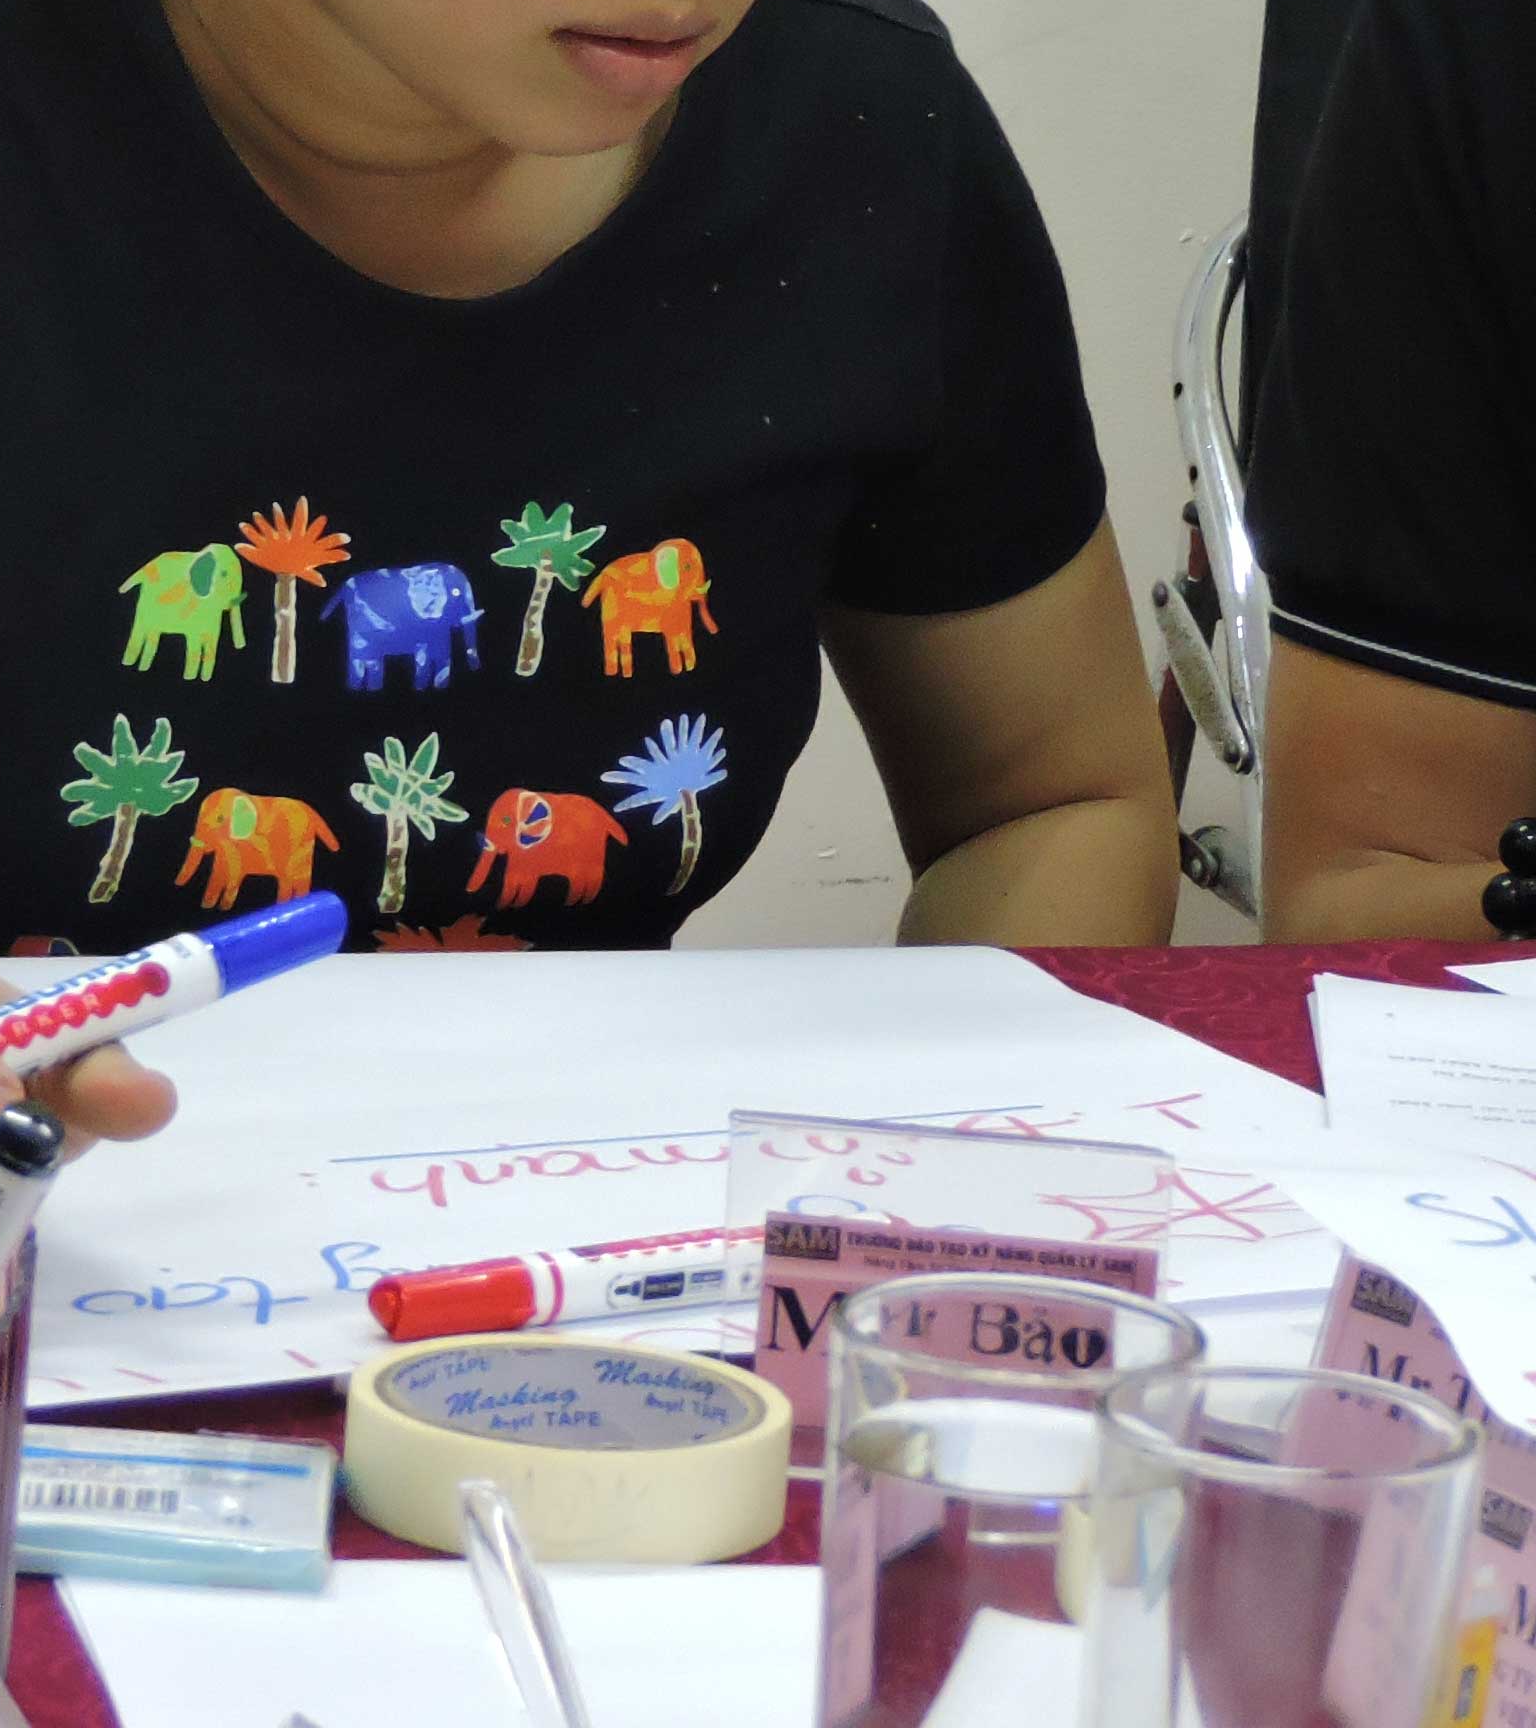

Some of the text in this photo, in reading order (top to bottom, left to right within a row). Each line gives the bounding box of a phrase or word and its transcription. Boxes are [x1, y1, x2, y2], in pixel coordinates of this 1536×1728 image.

[766, 1225, 840, 1253] SAM
[592, 1359, 720, 1396] Masking
[445, 1382, 580, 1418] Masking
[544, 1410, 602, 1428] TAPE
